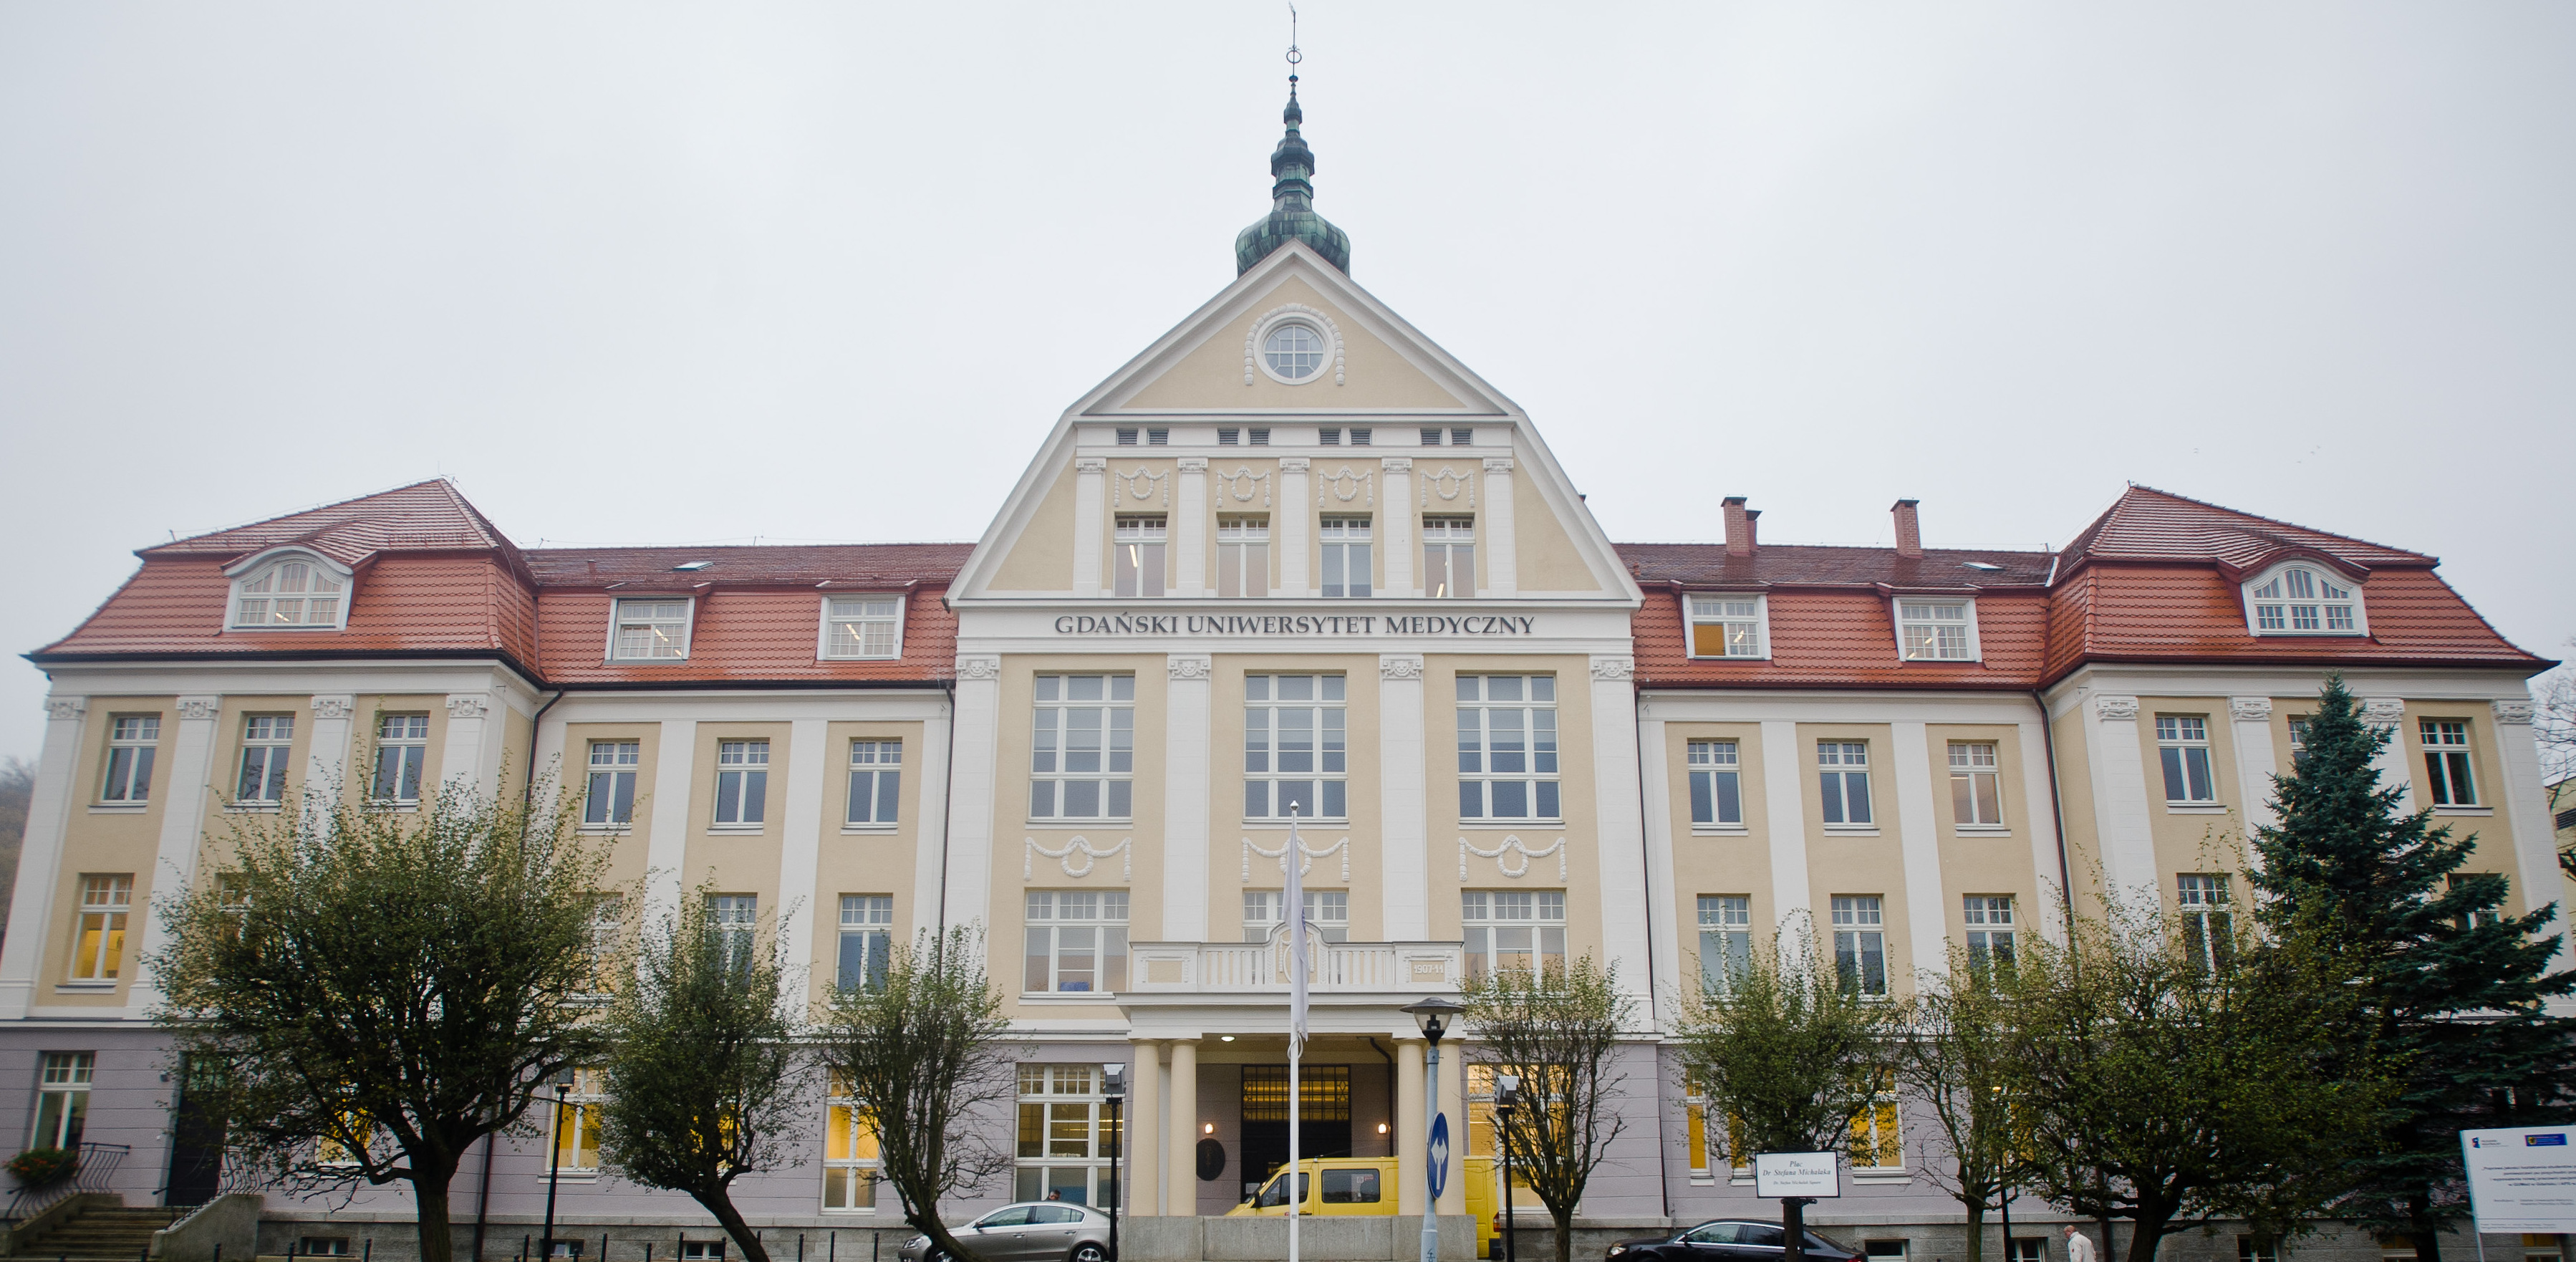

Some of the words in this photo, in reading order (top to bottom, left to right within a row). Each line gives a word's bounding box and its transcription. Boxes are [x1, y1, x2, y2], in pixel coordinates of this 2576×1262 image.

[1055, 612, 1179, 634] GDAŃSKI
[1186, 615, 1376, 634] UNIWERSYTET
[1385, 616, 1535, 634] MEDYCZNY
[1414, 964, 1444, 974] 1907-11
